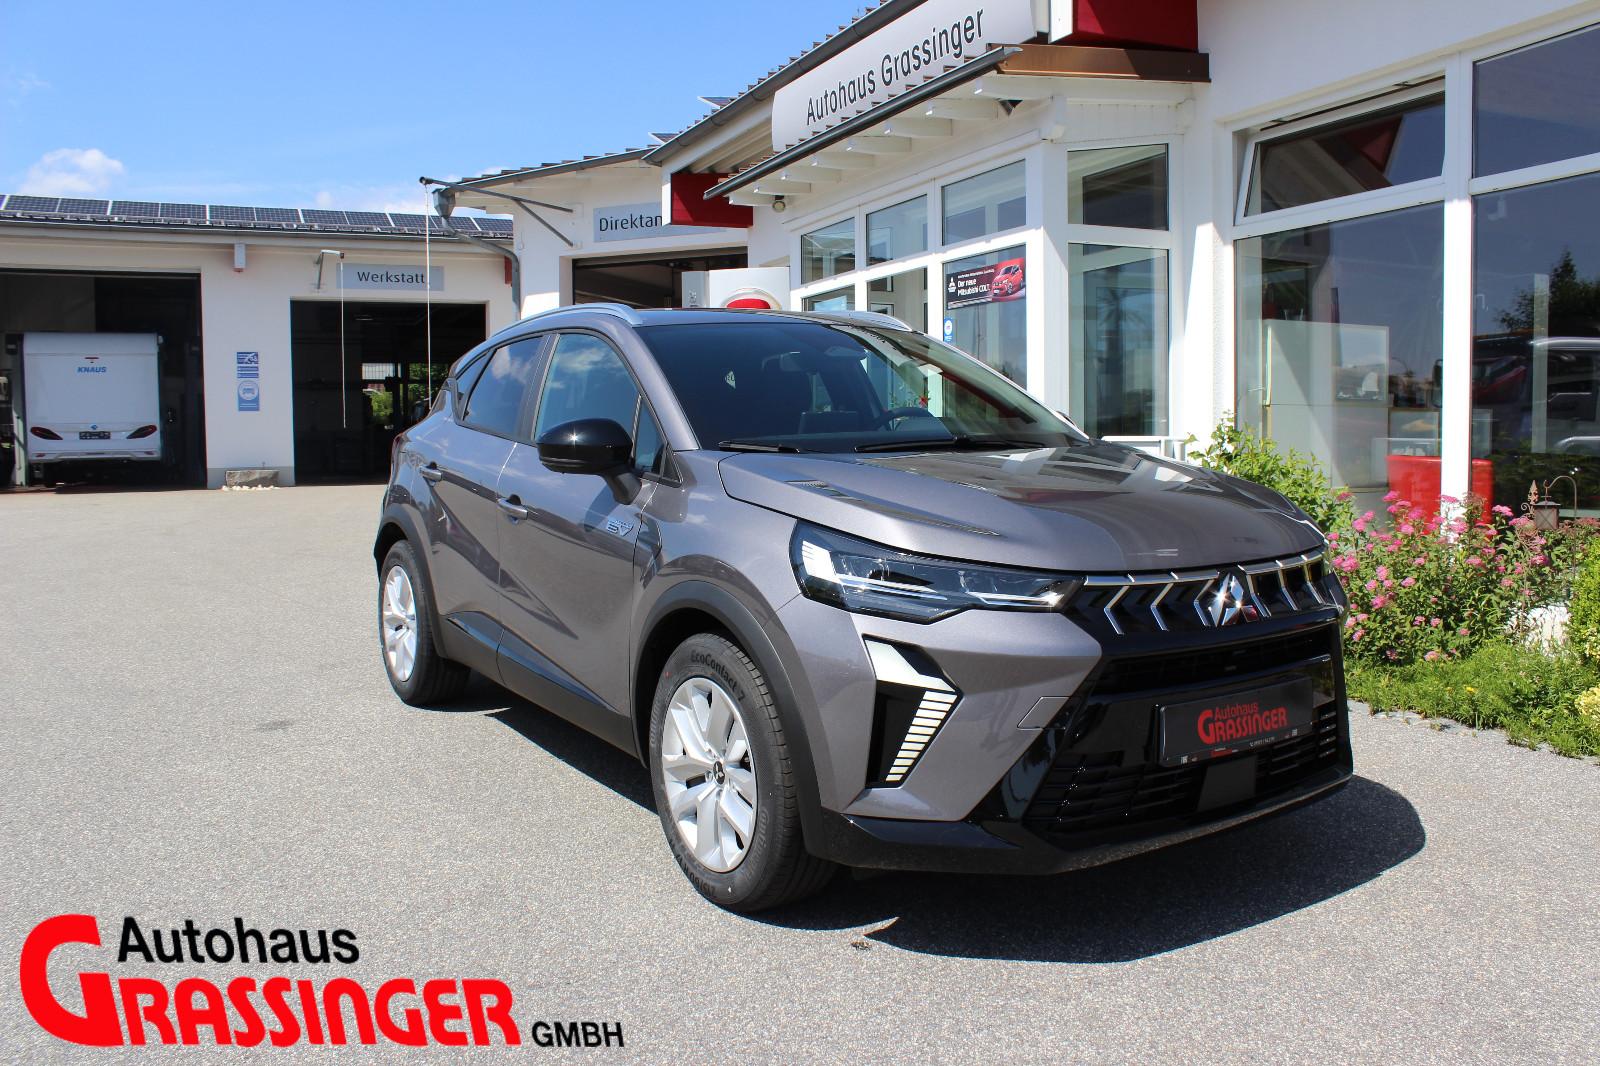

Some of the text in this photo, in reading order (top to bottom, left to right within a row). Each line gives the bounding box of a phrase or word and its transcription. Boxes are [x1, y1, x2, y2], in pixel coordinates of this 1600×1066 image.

[806, 9, 984, 126] Autohaus Grassinger
[357, 271, 425, 284] Werkstatt
[690, 649, 738, 693] EcoContact
[1214, 703, 1259, 719] Autohaus
